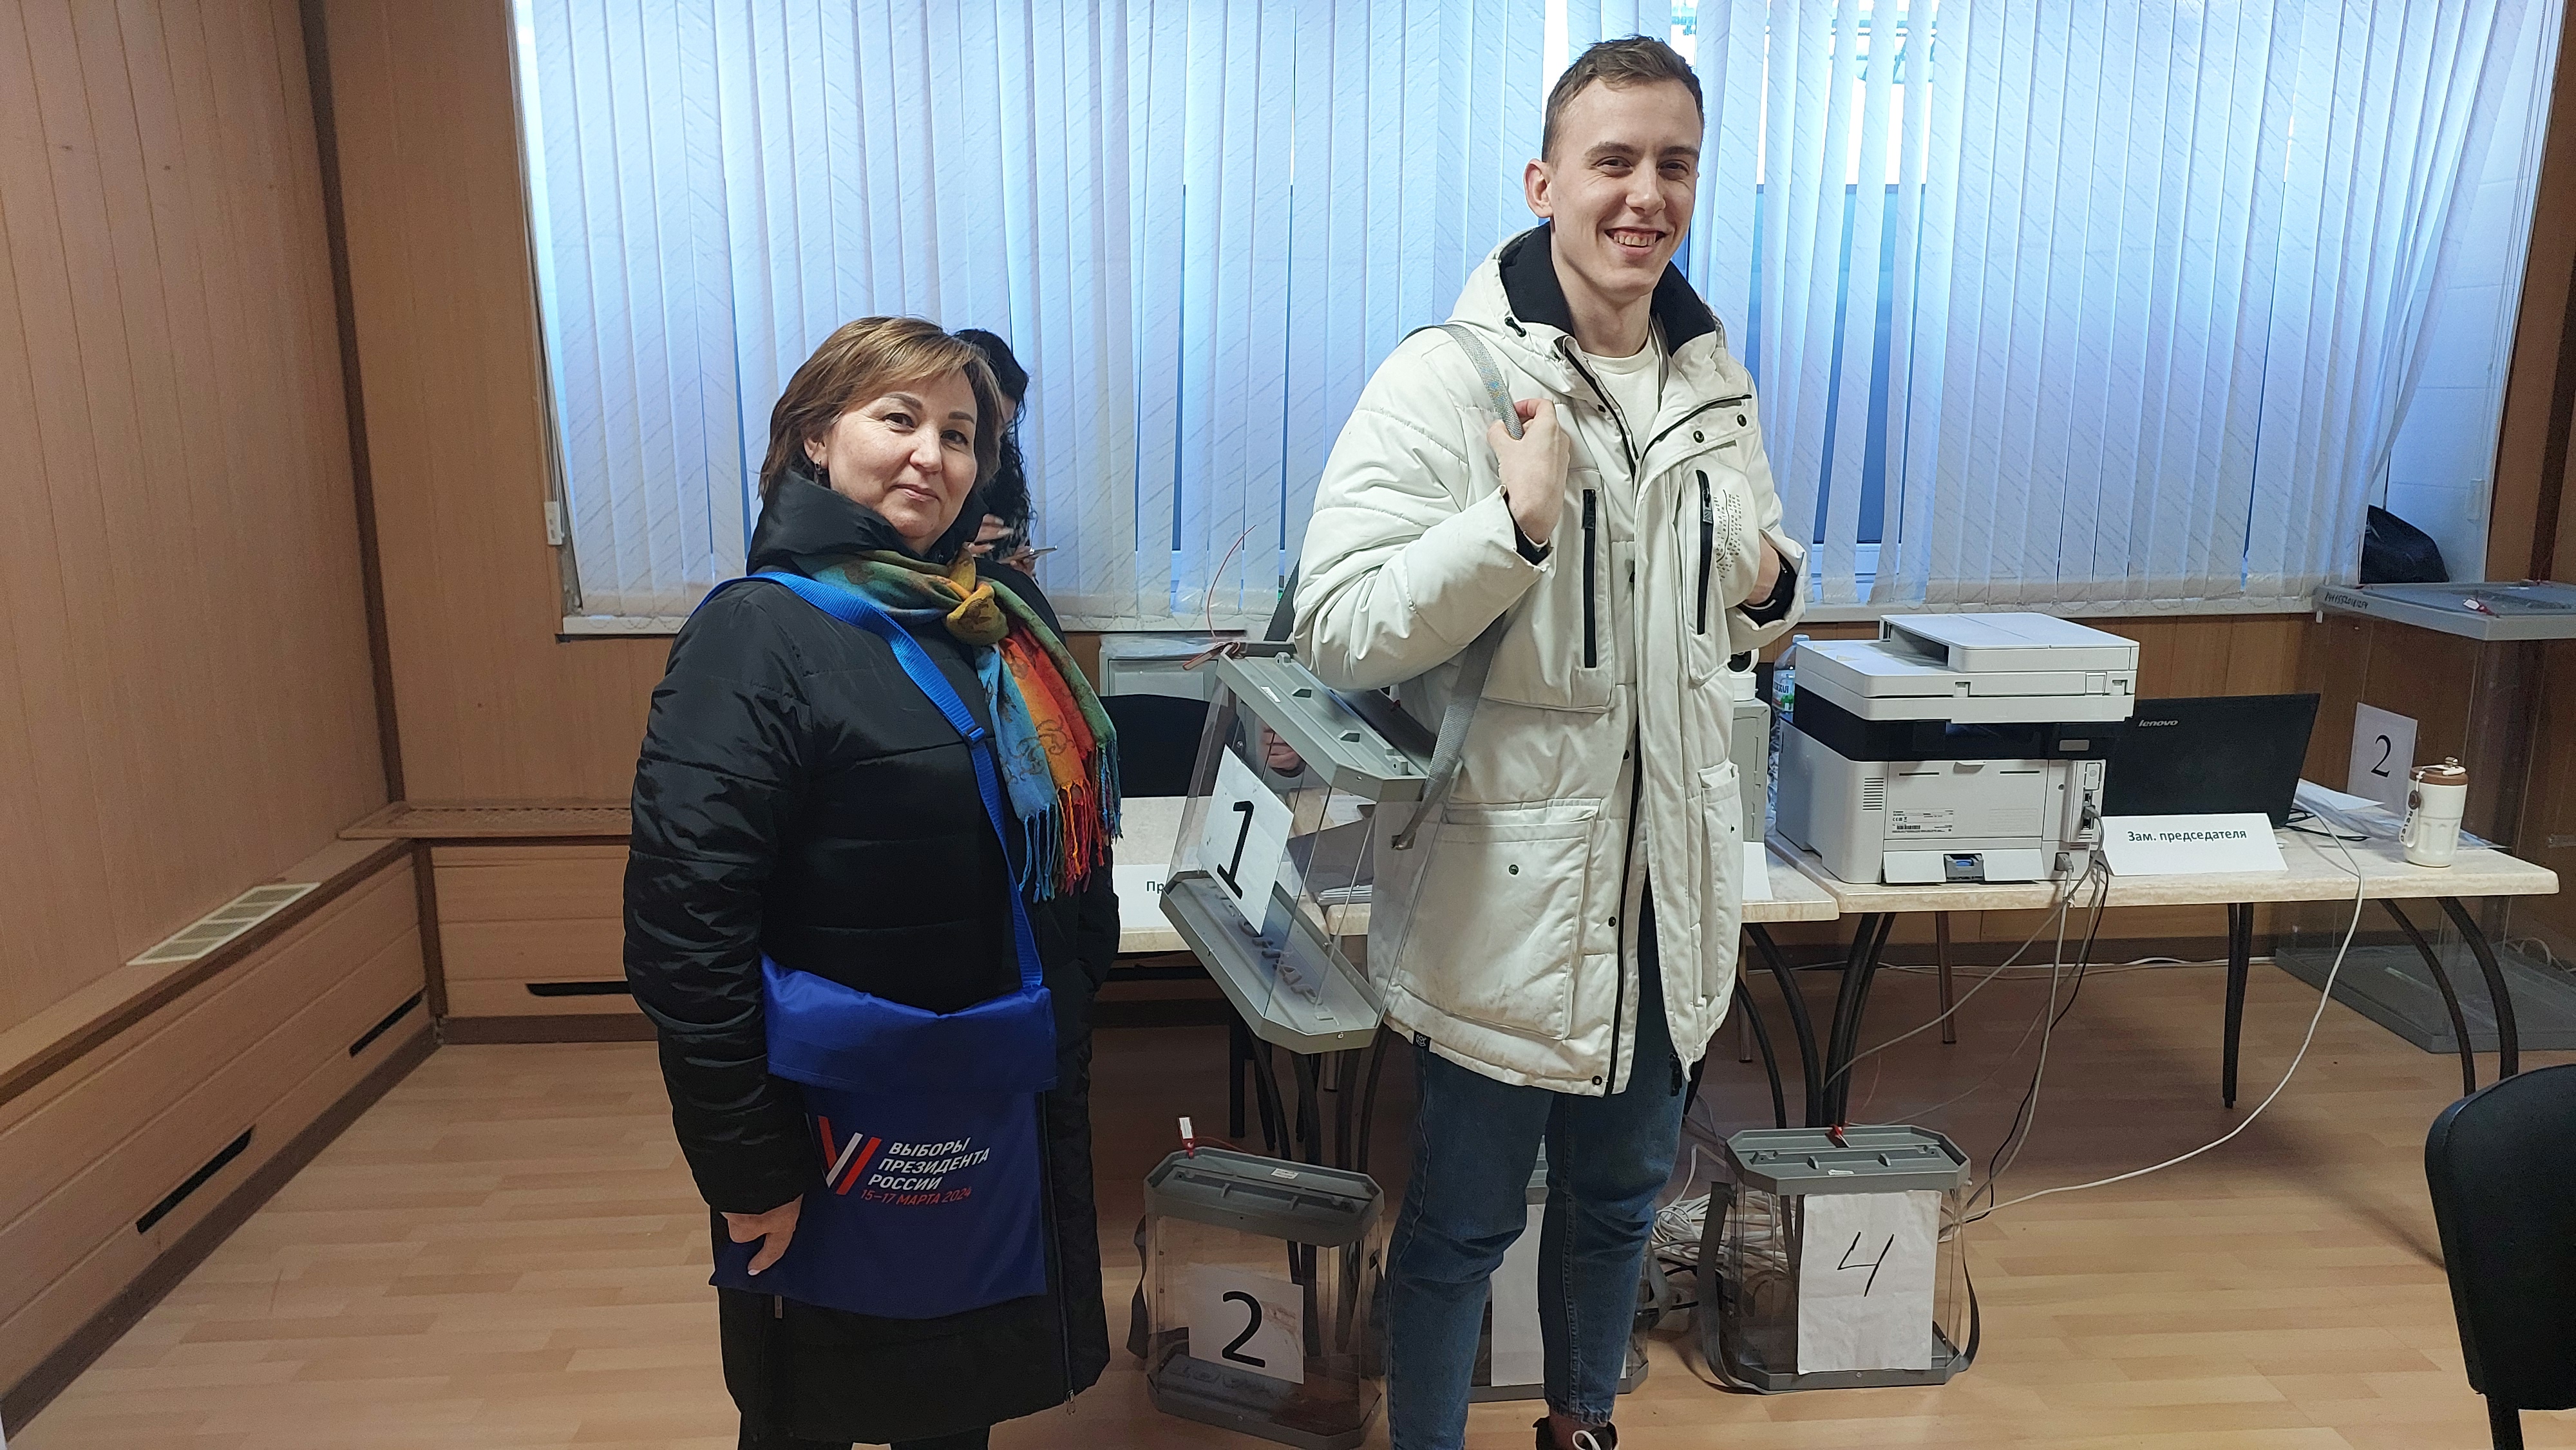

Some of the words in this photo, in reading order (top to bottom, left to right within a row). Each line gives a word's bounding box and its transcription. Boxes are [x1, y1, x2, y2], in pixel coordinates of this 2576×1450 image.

[2371, 735, 2391, 778] 2
[1217, 800, 1255, 900] 1
[2127, 831, 2157, 842] Зам.
[2159, 831, 2247, 843] председателя
[888, 1136, 971, 1157] ВЫБОРЫ
[878, 1147, 990, 1175] ПРЕЗИДЕНТА
[867, 1174, 943, 1191] РОССИИ
[896, 1192, 941, 1205] МАРТА
[941, 1186, 972, 1203] 2024
[1837, 1230, 1895, 1298] 4
[1221, 1290, 1267, 1369] 2
